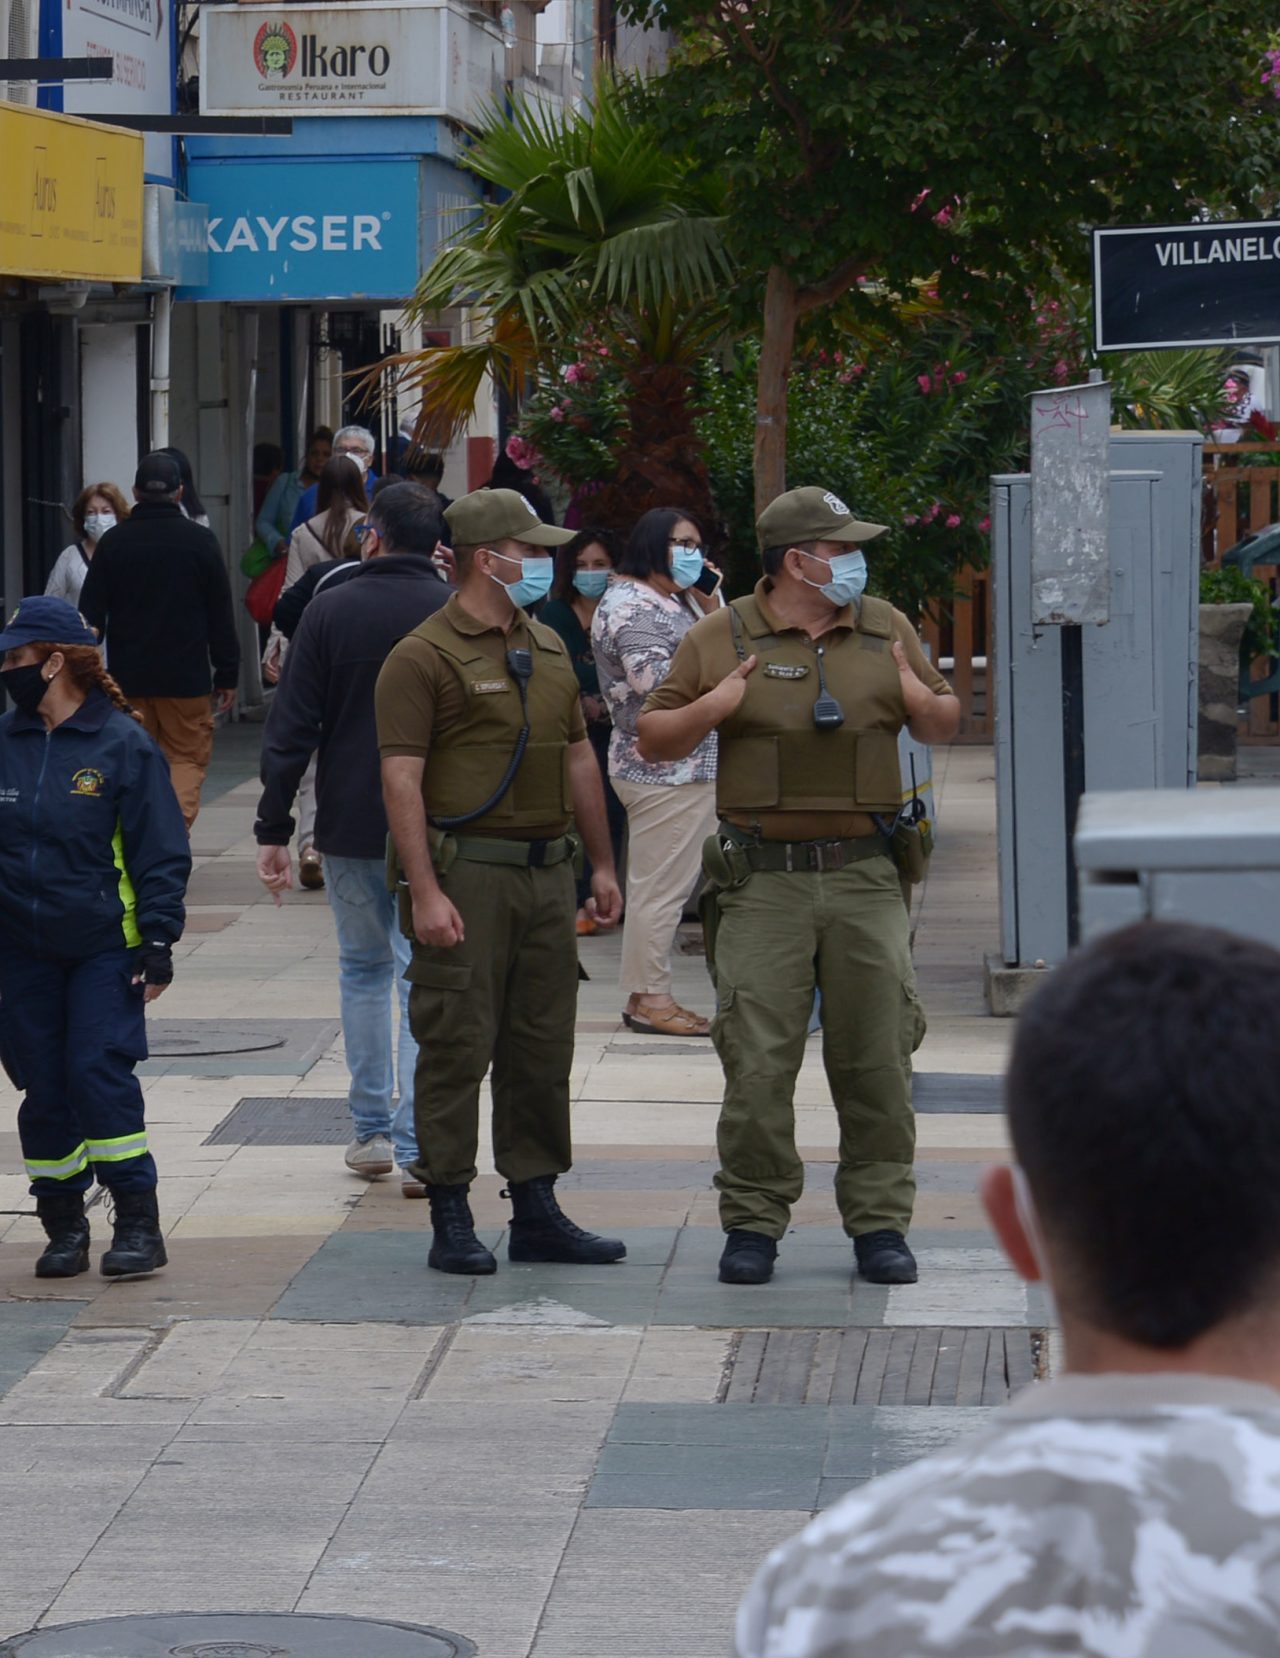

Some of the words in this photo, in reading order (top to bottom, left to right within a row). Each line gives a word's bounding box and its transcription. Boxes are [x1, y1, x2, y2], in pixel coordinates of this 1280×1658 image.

[301, 34, 390, 78] Ikaro
[279, 91, 365, 101] RESTAURANT
[341, 82, 386, 91] Internacional
[32, 168, 57, 213] Aurus
[94, 177, 116, 220] Aurus
